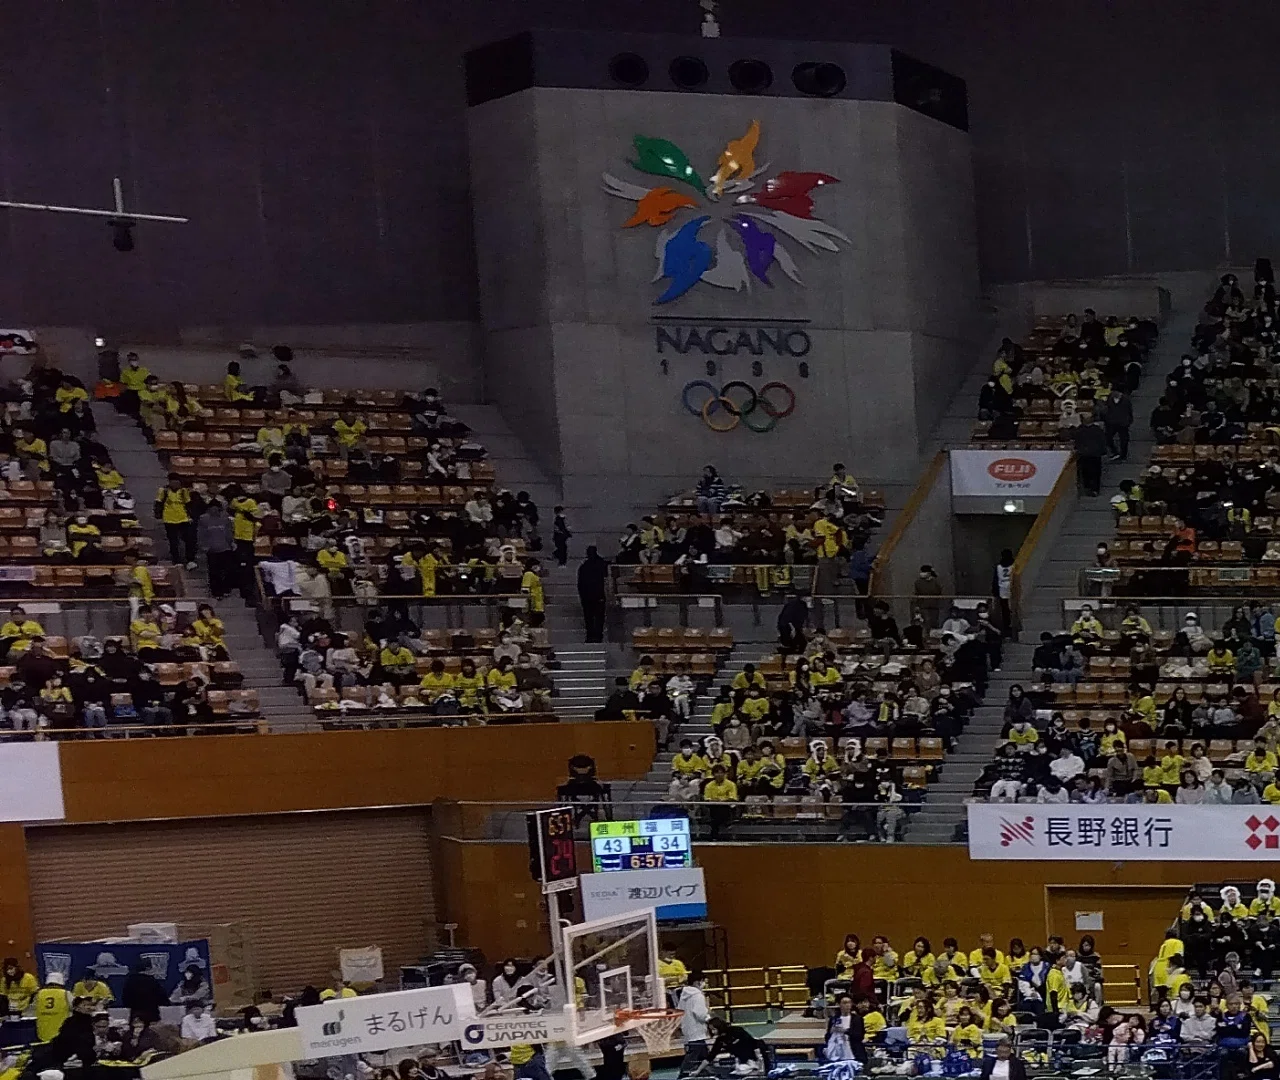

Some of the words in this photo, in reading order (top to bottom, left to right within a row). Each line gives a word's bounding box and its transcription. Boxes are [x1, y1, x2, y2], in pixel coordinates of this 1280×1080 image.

[656, 327, 812, 358] NAGANO
[994, 464, 1031, 473] FUJI
[1044, 817, 1173, 848] 長野銀行
[603, 839, 623, 853] 43
[660, 837, 680, 850] 34
[630, 854, 664, 868] 6:57
[628, 884, 699, 899] 渡辺パイプ
[45, 997, 55, 1009] 3
[364, 1005, 452, 1035] まるげん
[486, 1020, 547, 1030] CERATEC
[310, 1035, 361, 1049] marugen
[487, 1029, 548, 1042] JAPAN
